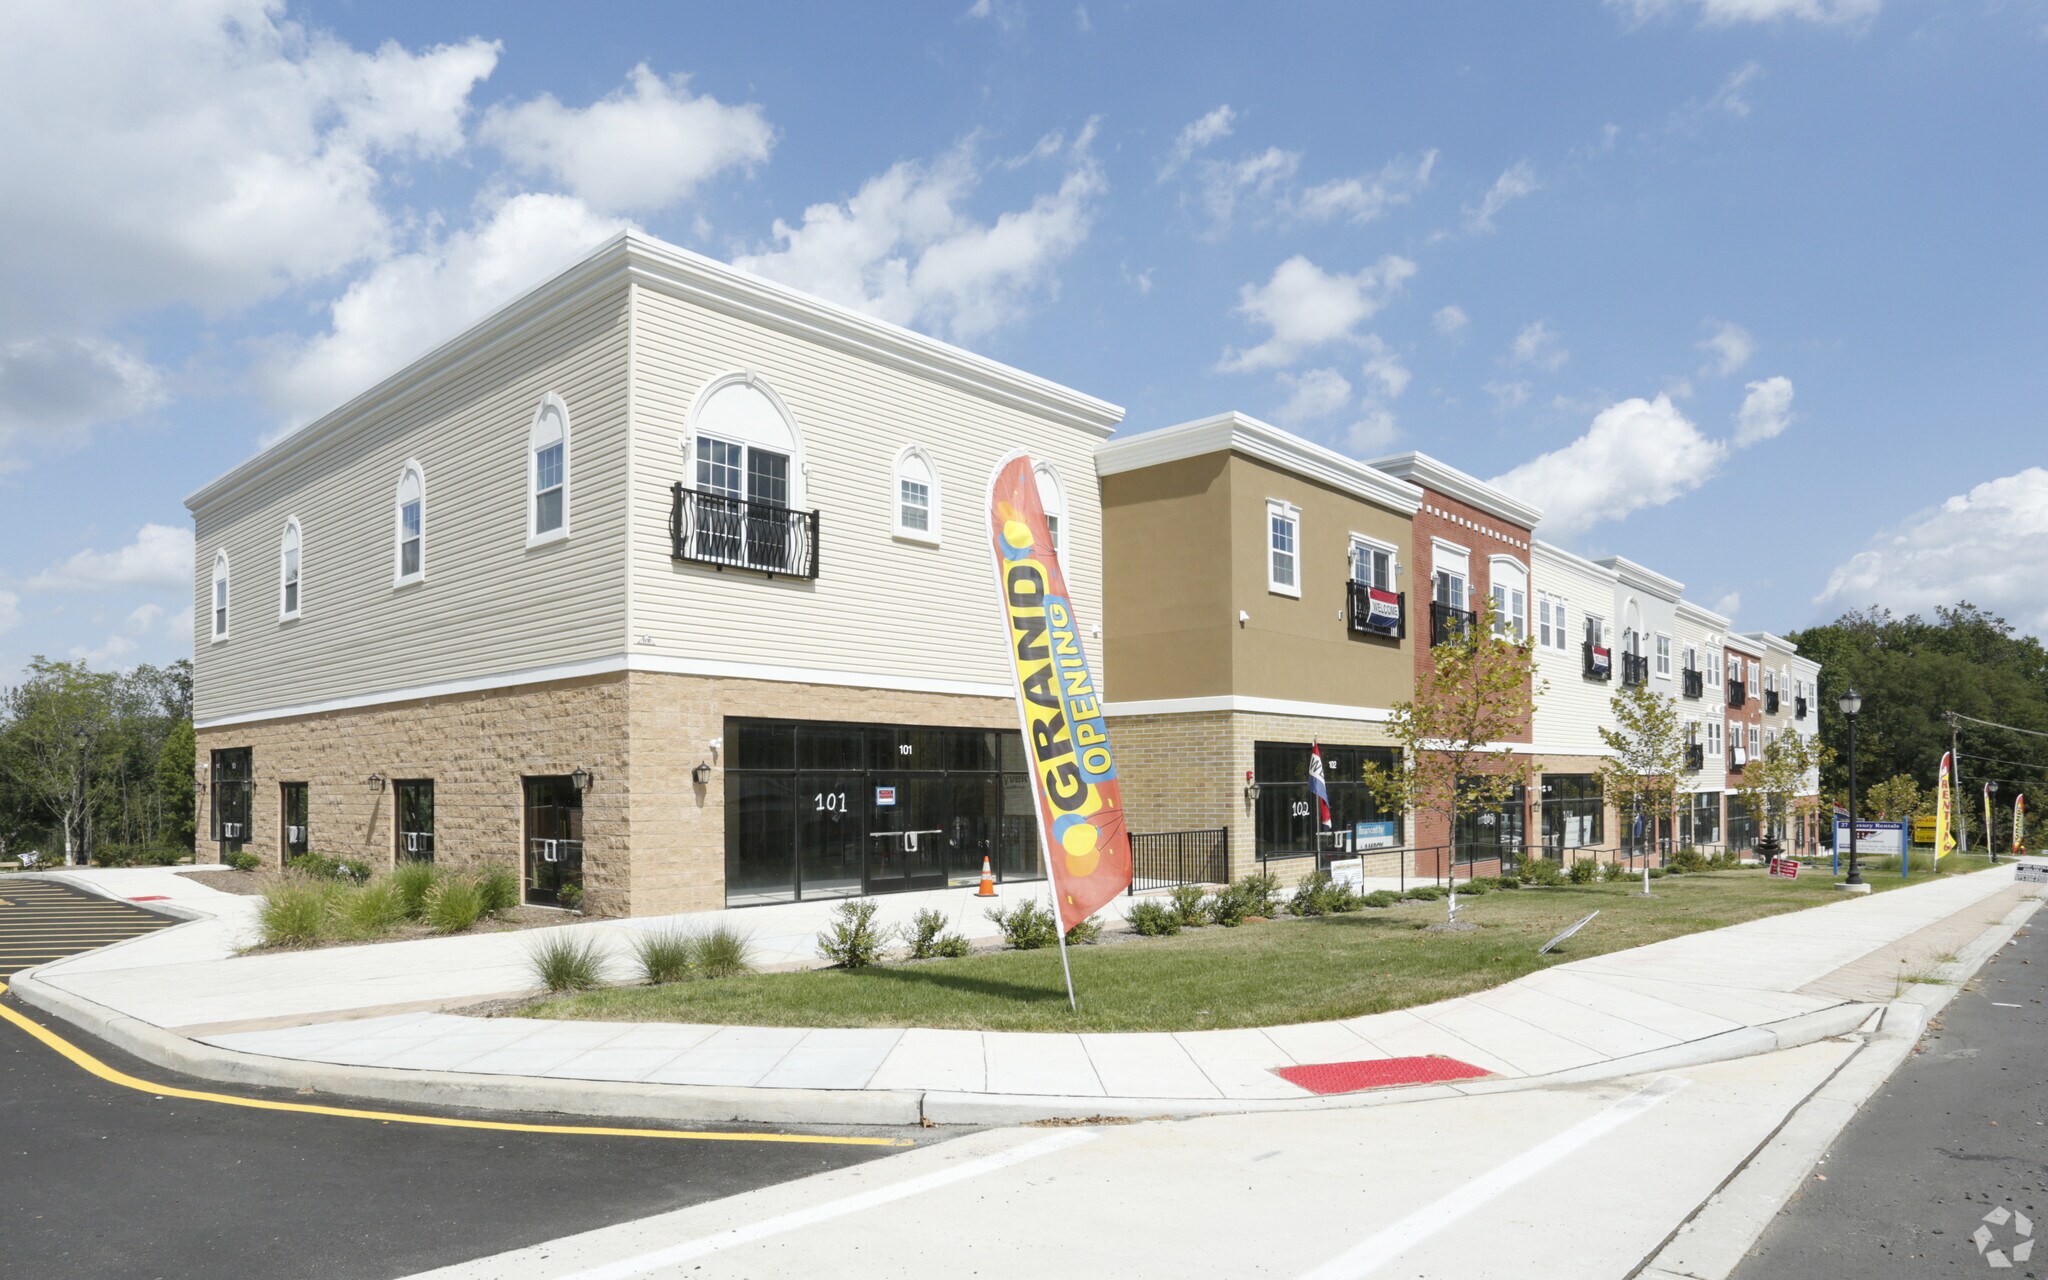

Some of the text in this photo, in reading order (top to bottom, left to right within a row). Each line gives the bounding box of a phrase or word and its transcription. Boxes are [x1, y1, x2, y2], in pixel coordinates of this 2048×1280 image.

[1372, 601, 1398, 616] WELCOME
[1007, 565, 1089, 813] GRAND
[1050, 602, 1111, 777] OPENING
[899, 744, 913, 755] 101
[1328, 760, 1337, 769] 102
[815, 792, 847, 812] 101
[1292, 801, 1310, 816] 102
